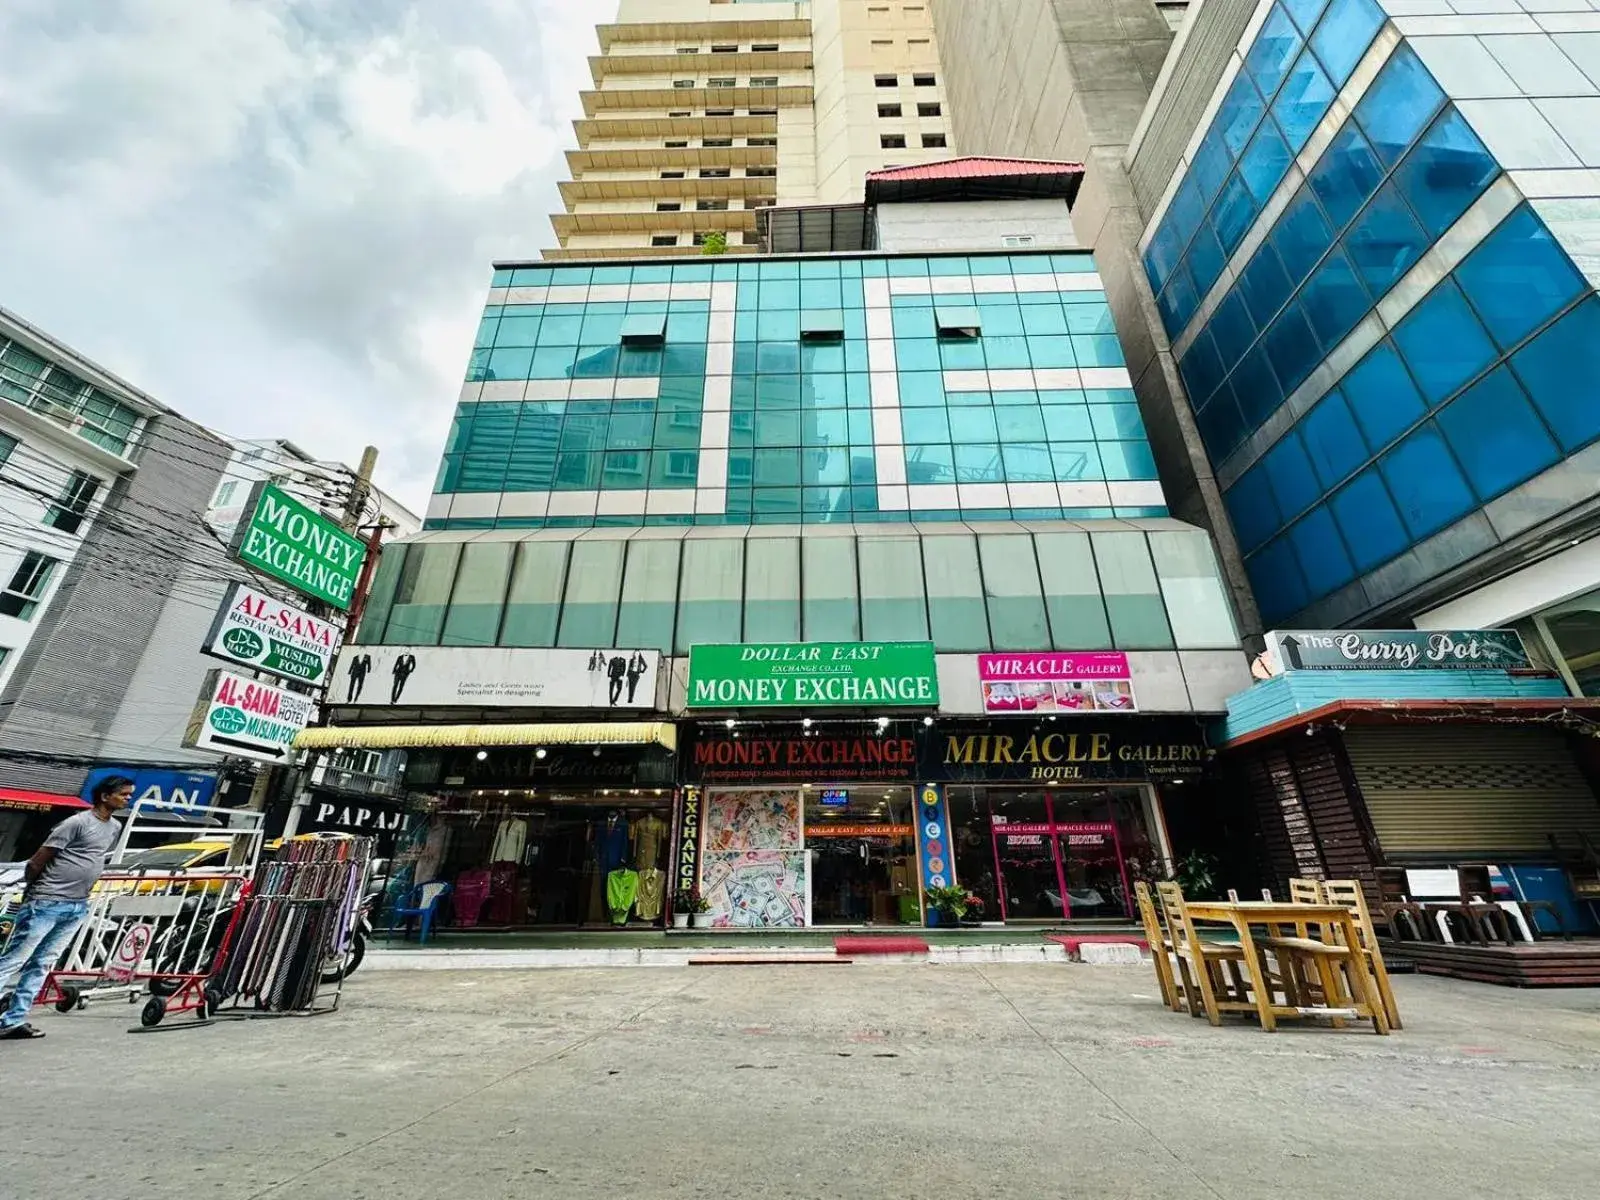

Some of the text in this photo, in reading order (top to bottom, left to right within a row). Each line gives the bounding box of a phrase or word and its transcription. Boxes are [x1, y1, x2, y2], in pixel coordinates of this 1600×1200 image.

[258, 495, 359, 571] MONEY
[245, 526, 352, 601] EXCHANGE
[235, 594, 330, 646] AL-SANA
[230, 612, 293, 643] RESTAURANT
[300, 639, 330, 656] HOTEL
[274, 644, 319, 667] MUSLIM
[741, 647, 883, 660] DOLLAR EAST
[1302, 633, 1482, 667] The Curry Pot
[278, 659, 310, 677] FOOD
[986, 659, 1122, 674] MIRACLE GALLERY
[216, 677, 280, 717] AL-SANA
[457, 689, 493, 697] Specialist
[695, 677, 932, 701] MONEY EXCHANGE
[277, 708, 304, 725] HOTEL
[245, 717, 299, 745] MUSLIM FOO
[694, 739, 915, 765] MONEY EXCHANGE
[944, 733, 1203, 764] MIRACLE GALLERY
[1032, 767, 1082, 779] HOTEL
[823, 790, 847, 798] OPEN
[315, 803, 411, 831] PAPAJI
[680, 789, 698, 890] EXCHANGE
[1007, 834, 1042, 845] HOTEL
[1069, 834, 1105, 845] HOTEL
